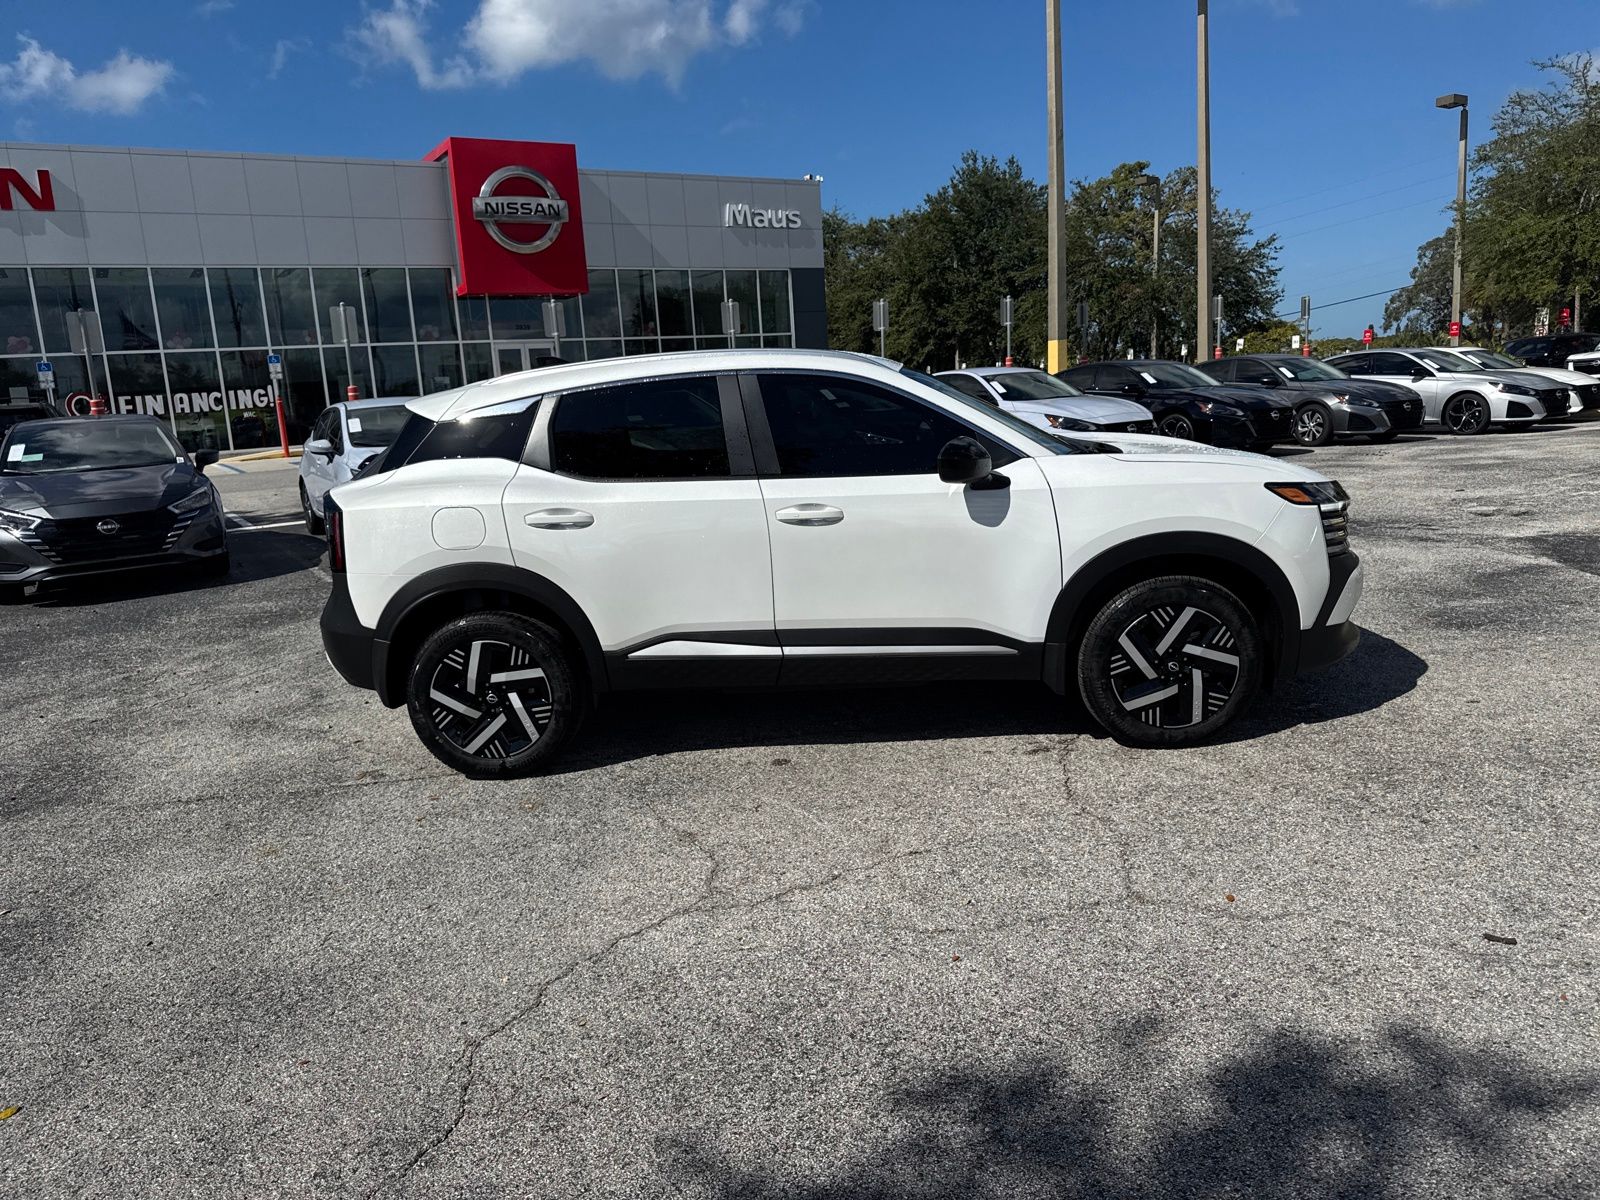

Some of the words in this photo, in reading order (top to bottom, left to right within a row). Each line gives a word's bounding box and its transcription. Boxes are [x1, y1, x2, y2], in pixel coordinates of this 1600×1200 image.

[0, 168, 55, 211] N
[484, 202, 560, 216] NISSAN
[724, 203, 802, 229] Maus
[119, 385, 274, 415] FINANCING!
